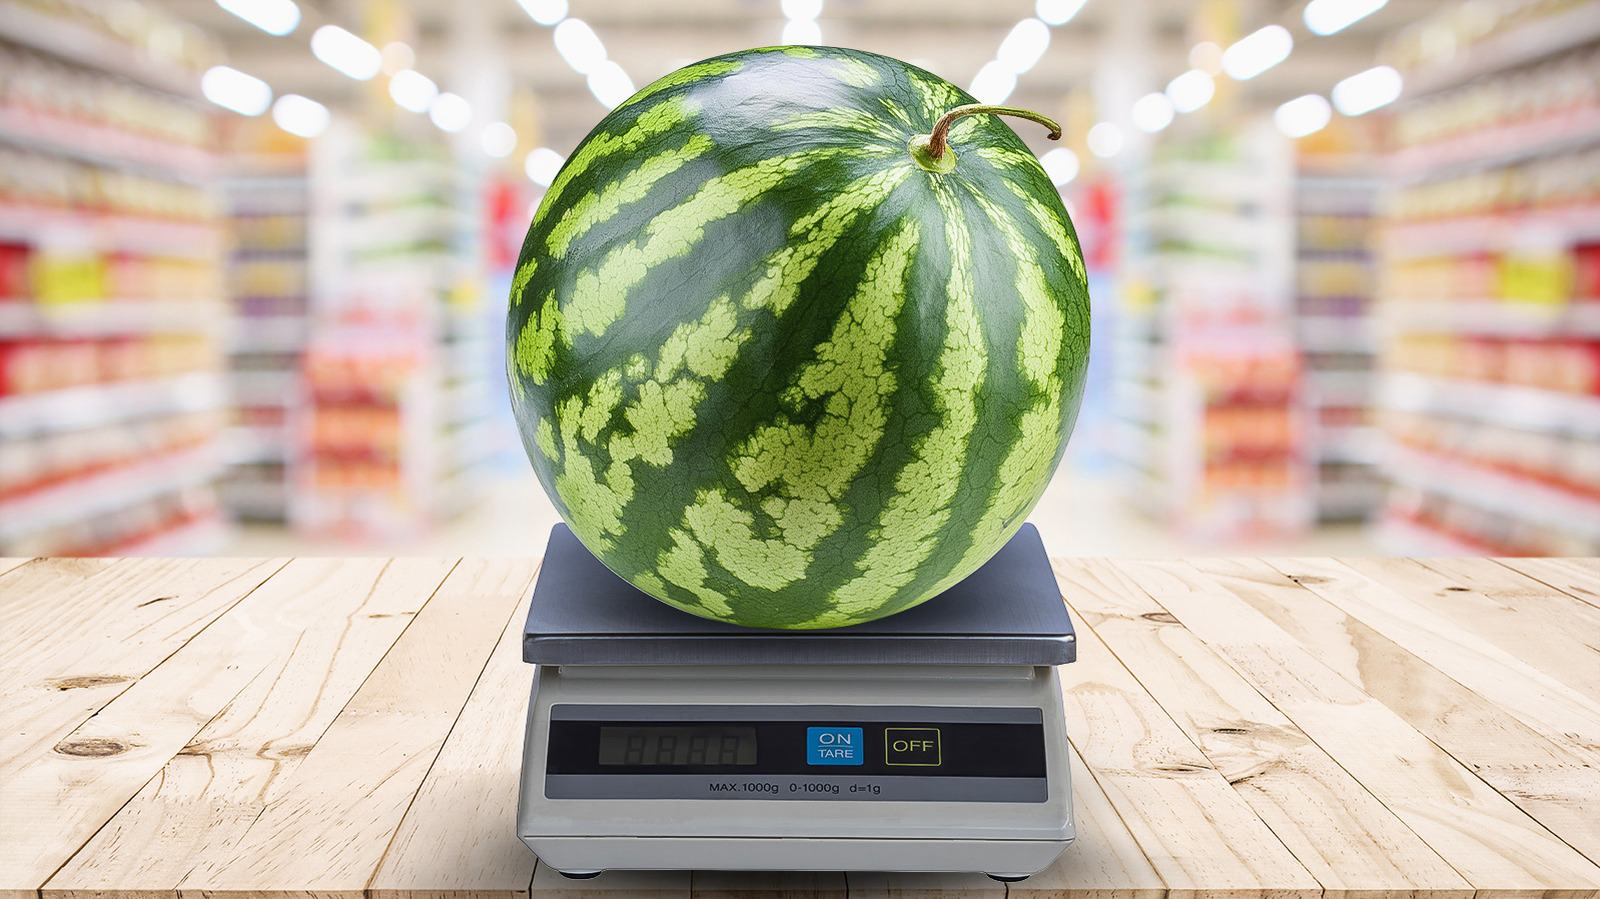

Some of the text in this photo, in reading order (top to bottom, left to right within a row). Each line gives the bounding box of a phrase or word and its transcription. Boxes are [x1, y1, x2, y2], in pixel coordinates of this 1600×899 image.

[819, 733, 851, 745] ON
[893, 740, 934, 752] OFF
[817, 749, 854, 758] TARE
[789, 783, 840, 795] 0-1000g
[849, 784, 881, 795] d=1g
